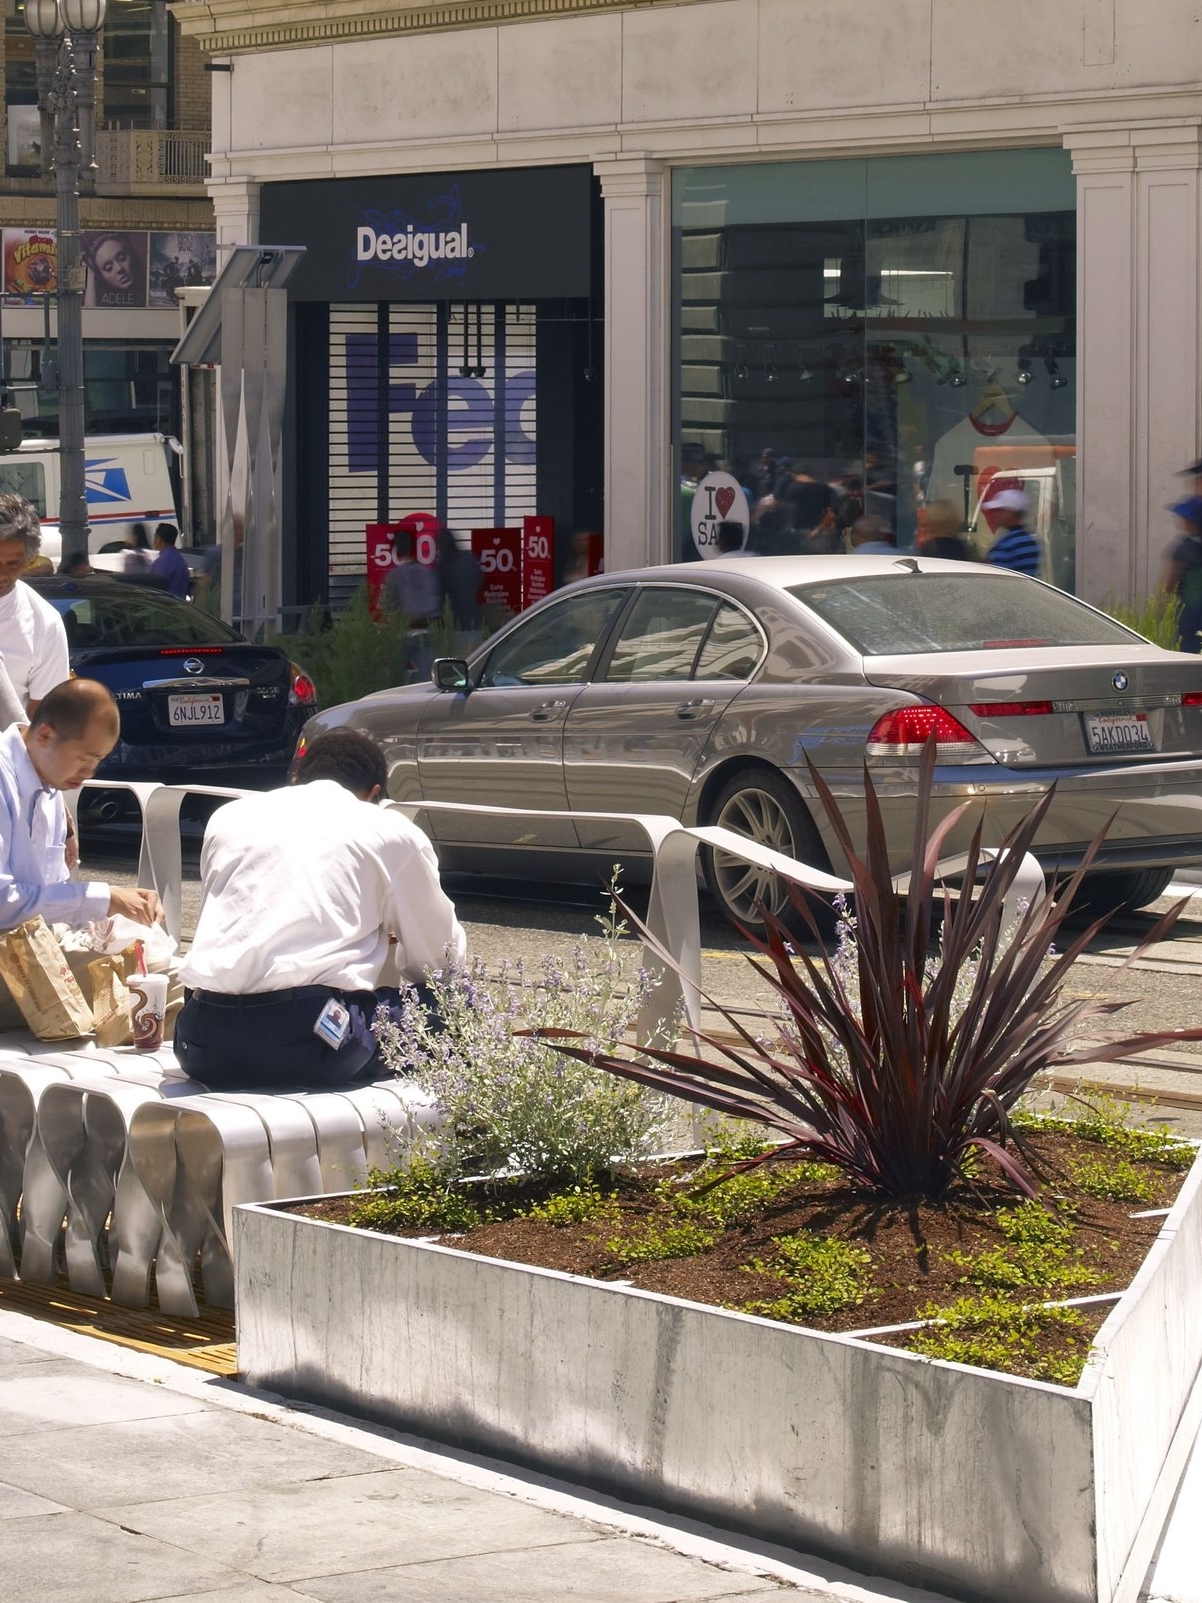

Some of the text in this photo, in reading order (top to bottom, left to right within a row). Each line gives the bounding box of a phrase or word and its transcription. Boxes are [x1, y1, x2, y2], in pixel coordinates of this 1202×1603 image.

[357, 223, 468, 267] Desigual
[101, 292, 134, 304] ADELE
[704, 486, 716, 520] I
[179, 696, 212, 705] California
[174, 705, 220, 720] 6NJL912
[1098, 715, 1134, 725] California
[1092, 724, 1148, 745] 5AKD034
[1099, 742, 1147, 750] WEATHERFORD
